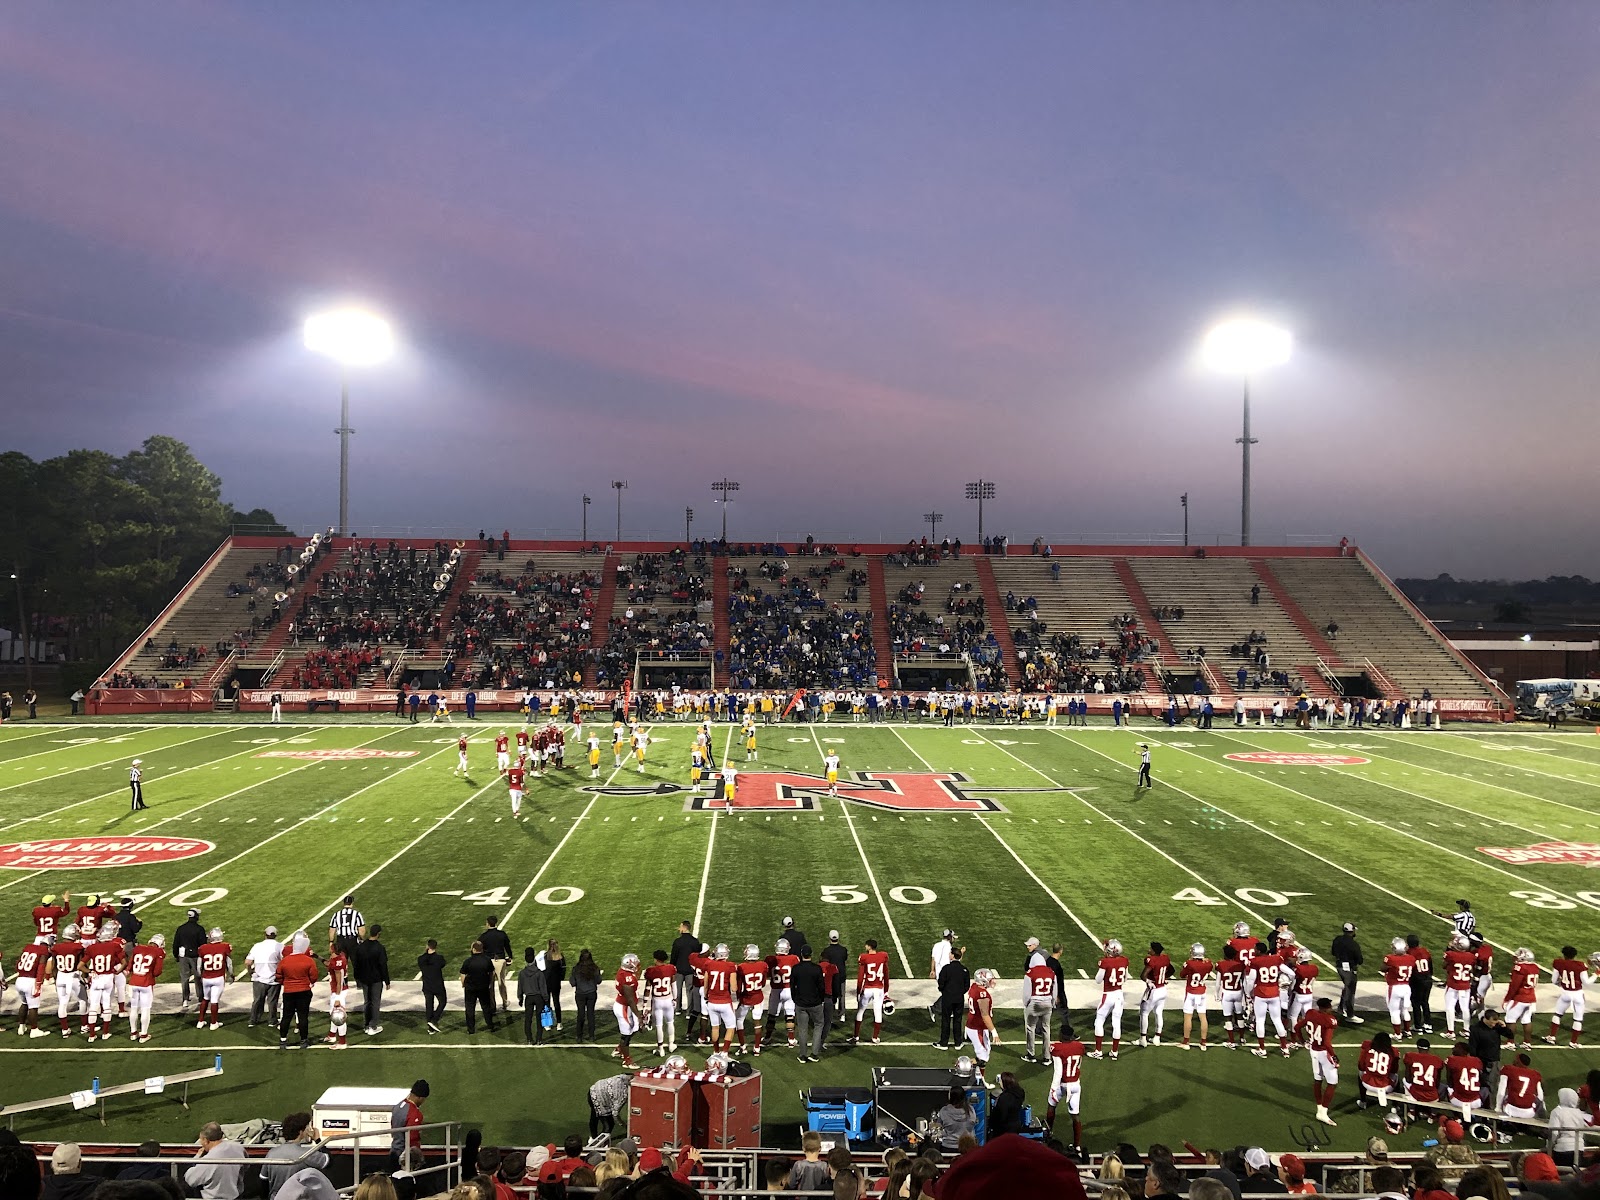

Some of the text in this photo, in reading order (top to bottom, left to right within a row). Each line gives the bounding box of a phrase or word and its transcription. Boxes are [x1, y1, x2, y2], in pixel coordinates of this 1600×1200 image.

[328, 691, 357, 700] BAYOU
[452, 692, 498, 700] OFF HOOK
[512, 775, 516, 783] 5
[685, 771, 1008, 812] N
[3, 843, 200, 852] MANNING
[4, 856, 138, 866] FIELD
[39, 917, 54, 932] 12
[82, 916, 94, 929] 15
[342, 915, 350, 926] L
[56, 954, 75, 972] 80
[94, 954, 112, 972] 81
[132, 954, 153, 975] 82
[204, 954, 224, 970] 28
[1416, 959, 1428, 973] 10
[710, 970, 724, 991] 71
[867, 962, 884, 982] 54
[1108, 967, 1126, 986] 43
[1158, 966, 1167, 984] 11
[1224, 972, 1242, 990] 27
[1259, 966, 1278, 983] 89
[1454, 963, 1472, 981] 32
[1560, 970, 1576, 989] 41
[652, 976, 672, 996] 29
[745, 972, 763, 992] 52
[1035, 978, 1052, 994] 23
[1066, 1055, 1080, 1077] 17
[1368, 1048, 1390, 1075] 38
[1412, 1062, 1434, 1086] 24
[1460, 1068, 1480, 1092] 42
[1518, 1076, 1530, 1098] 7
